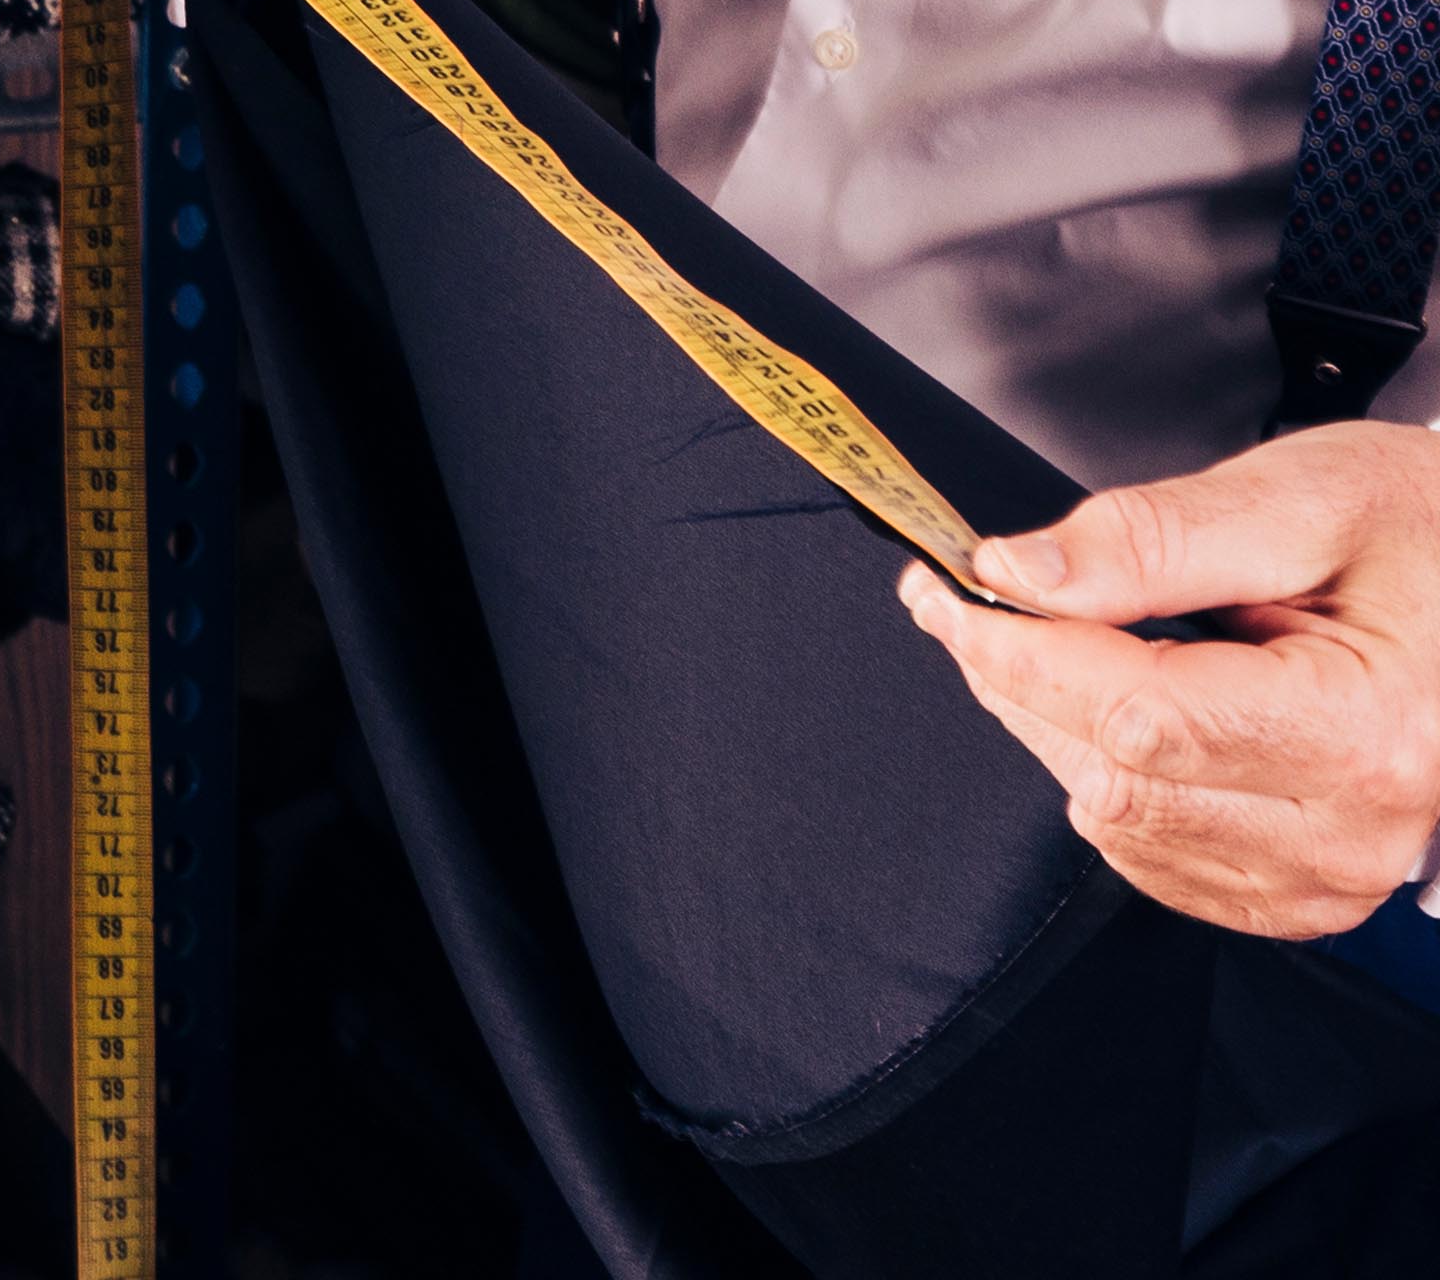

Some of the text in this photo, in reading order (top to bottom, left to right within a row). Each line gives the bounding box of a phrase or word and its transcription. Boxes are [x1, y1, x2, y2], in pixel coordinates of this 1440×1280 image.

[375, 10, 412, 27] 32
[396, 28, 430, 44] 31
[410, 46, 448, 62] 30
[86, 66, 107, 89] 90
[427, 64, 464, 79] 29
[444, 84, 482, 98] 28
[87, 106, 109, 128] 89
[464, 102, 499, 118] 27
[87, 145, 110, 168] 88
[88, 186, 112, 209] 87
[87, 229, 111, 249] 86
[88, 268, 111, 289] 85
[89, 308, 114, 330] 84
[90, 350, 113, 369] 83
[756, 362, 792, 379] 12
[91, 390, 114, 411] 82
[780, 380, 814, 399] 11
[801, 399, 836, 418] 10
[93, 430, 116, 452] 81
[92, 470, 117, 492] 80
[93, 511, 118, 532] 79
[93, 550, 117, 572] 78
[95, 631, 120, 653] 76
[95, 673, 118, 694] 75
[96, 714, 120, 736] 74
[97, 752, 120, 775] 73
[97, 793, 121, 817] 72
[99, 836, 123, 859] 71
[97, 875, 123, 897] 70
[99, 916, 122, 939] 69
[99, 957, 123, 979] 68
[101, 998, 124, 1020] 67
[100, 1038, 124, 1059] 66
[101, 1078, 124, 1101] 65
[102, 1120, 126, 1142] 64
[101, 1159, 126, 1181] 63
[101, 1198, 126, 1221] 62
[104, 1239, 127, 1263] 61
